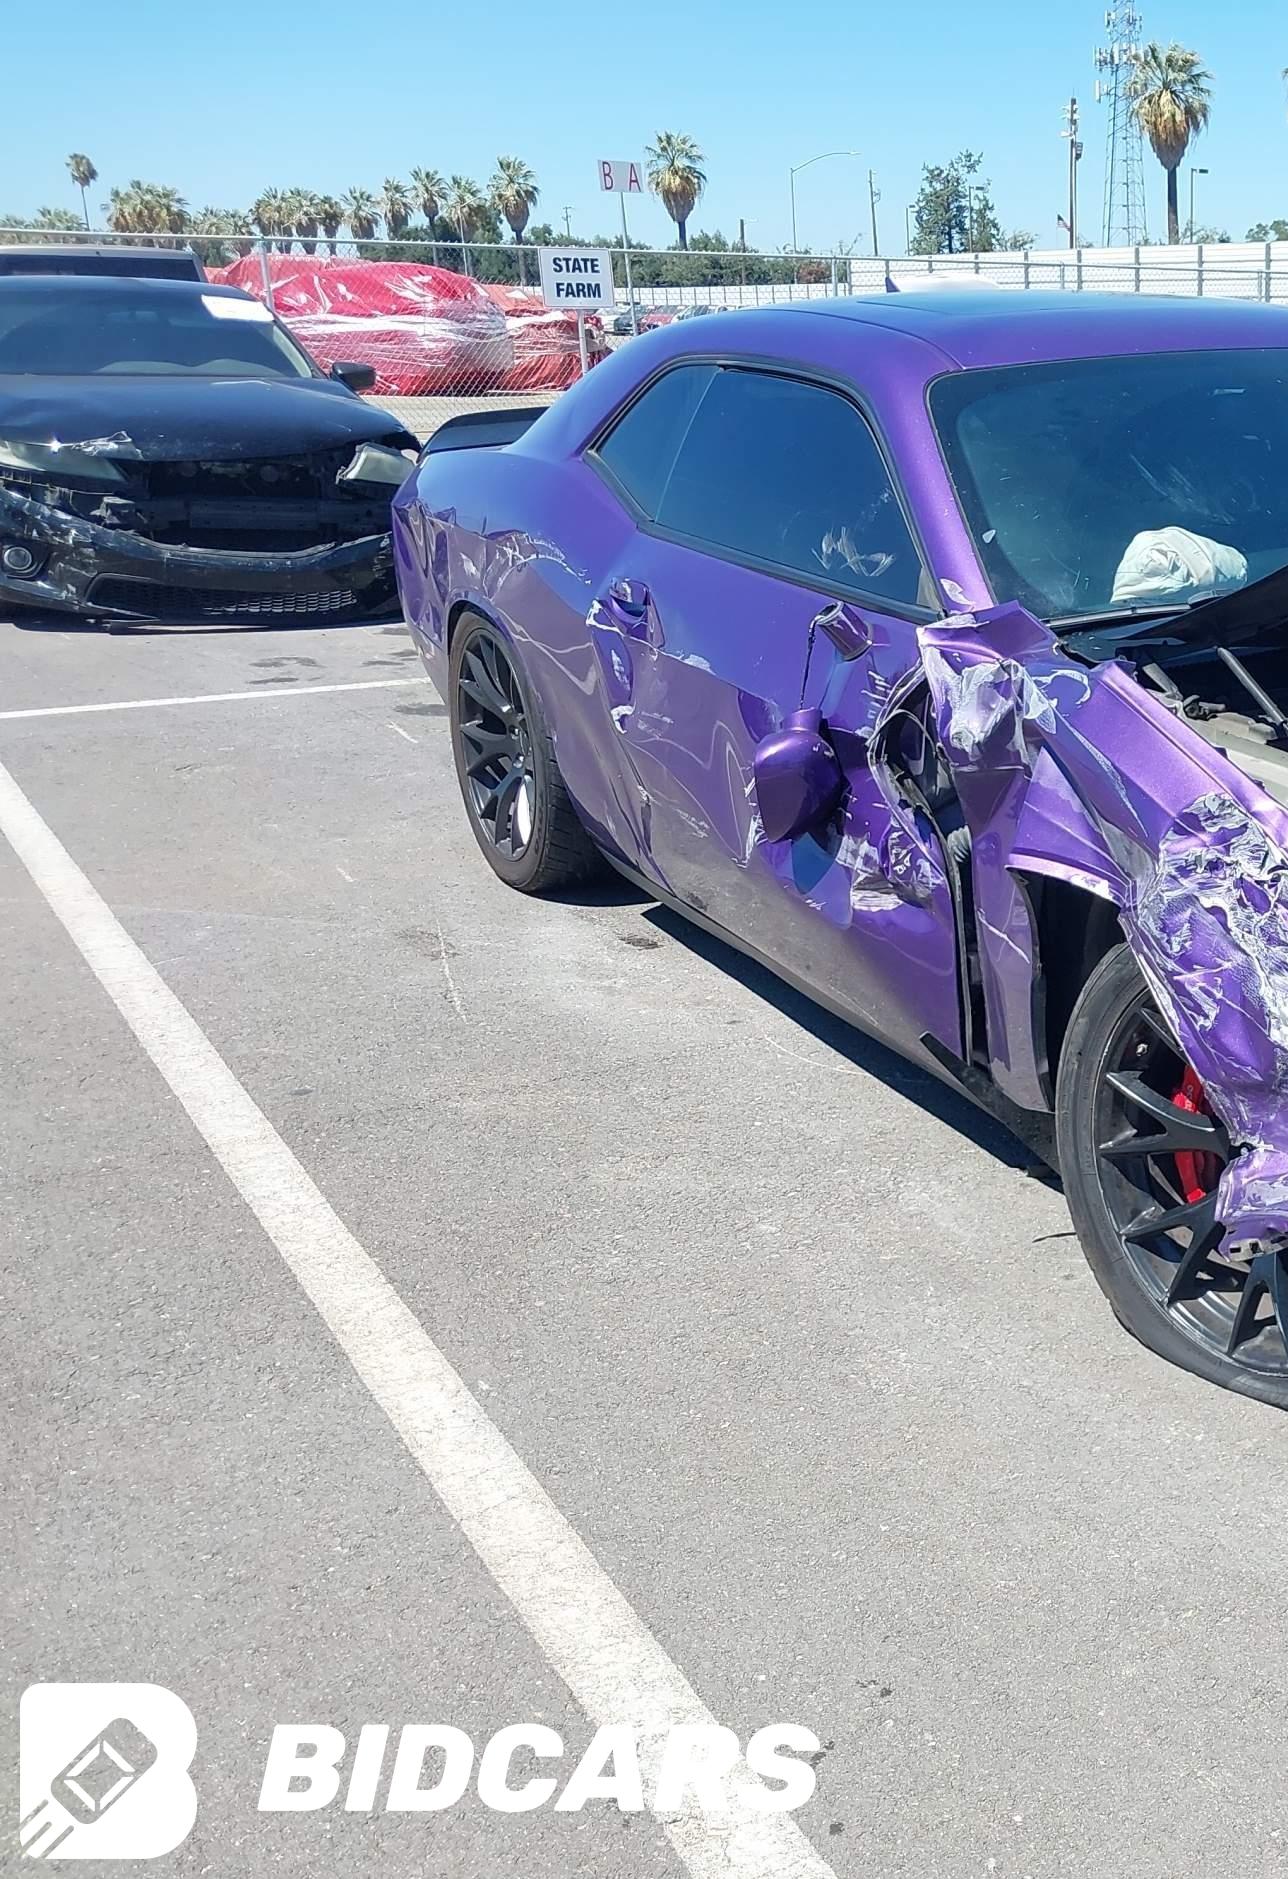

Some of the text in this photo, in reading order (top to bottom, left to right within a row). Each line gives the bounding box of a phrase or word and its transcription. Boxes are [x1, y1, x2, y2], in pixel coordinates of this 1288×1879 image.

[602, 161, 642, 192] B A
[552, 256, 600, 273] STATE
[556, 282, 602, 298] FARM
